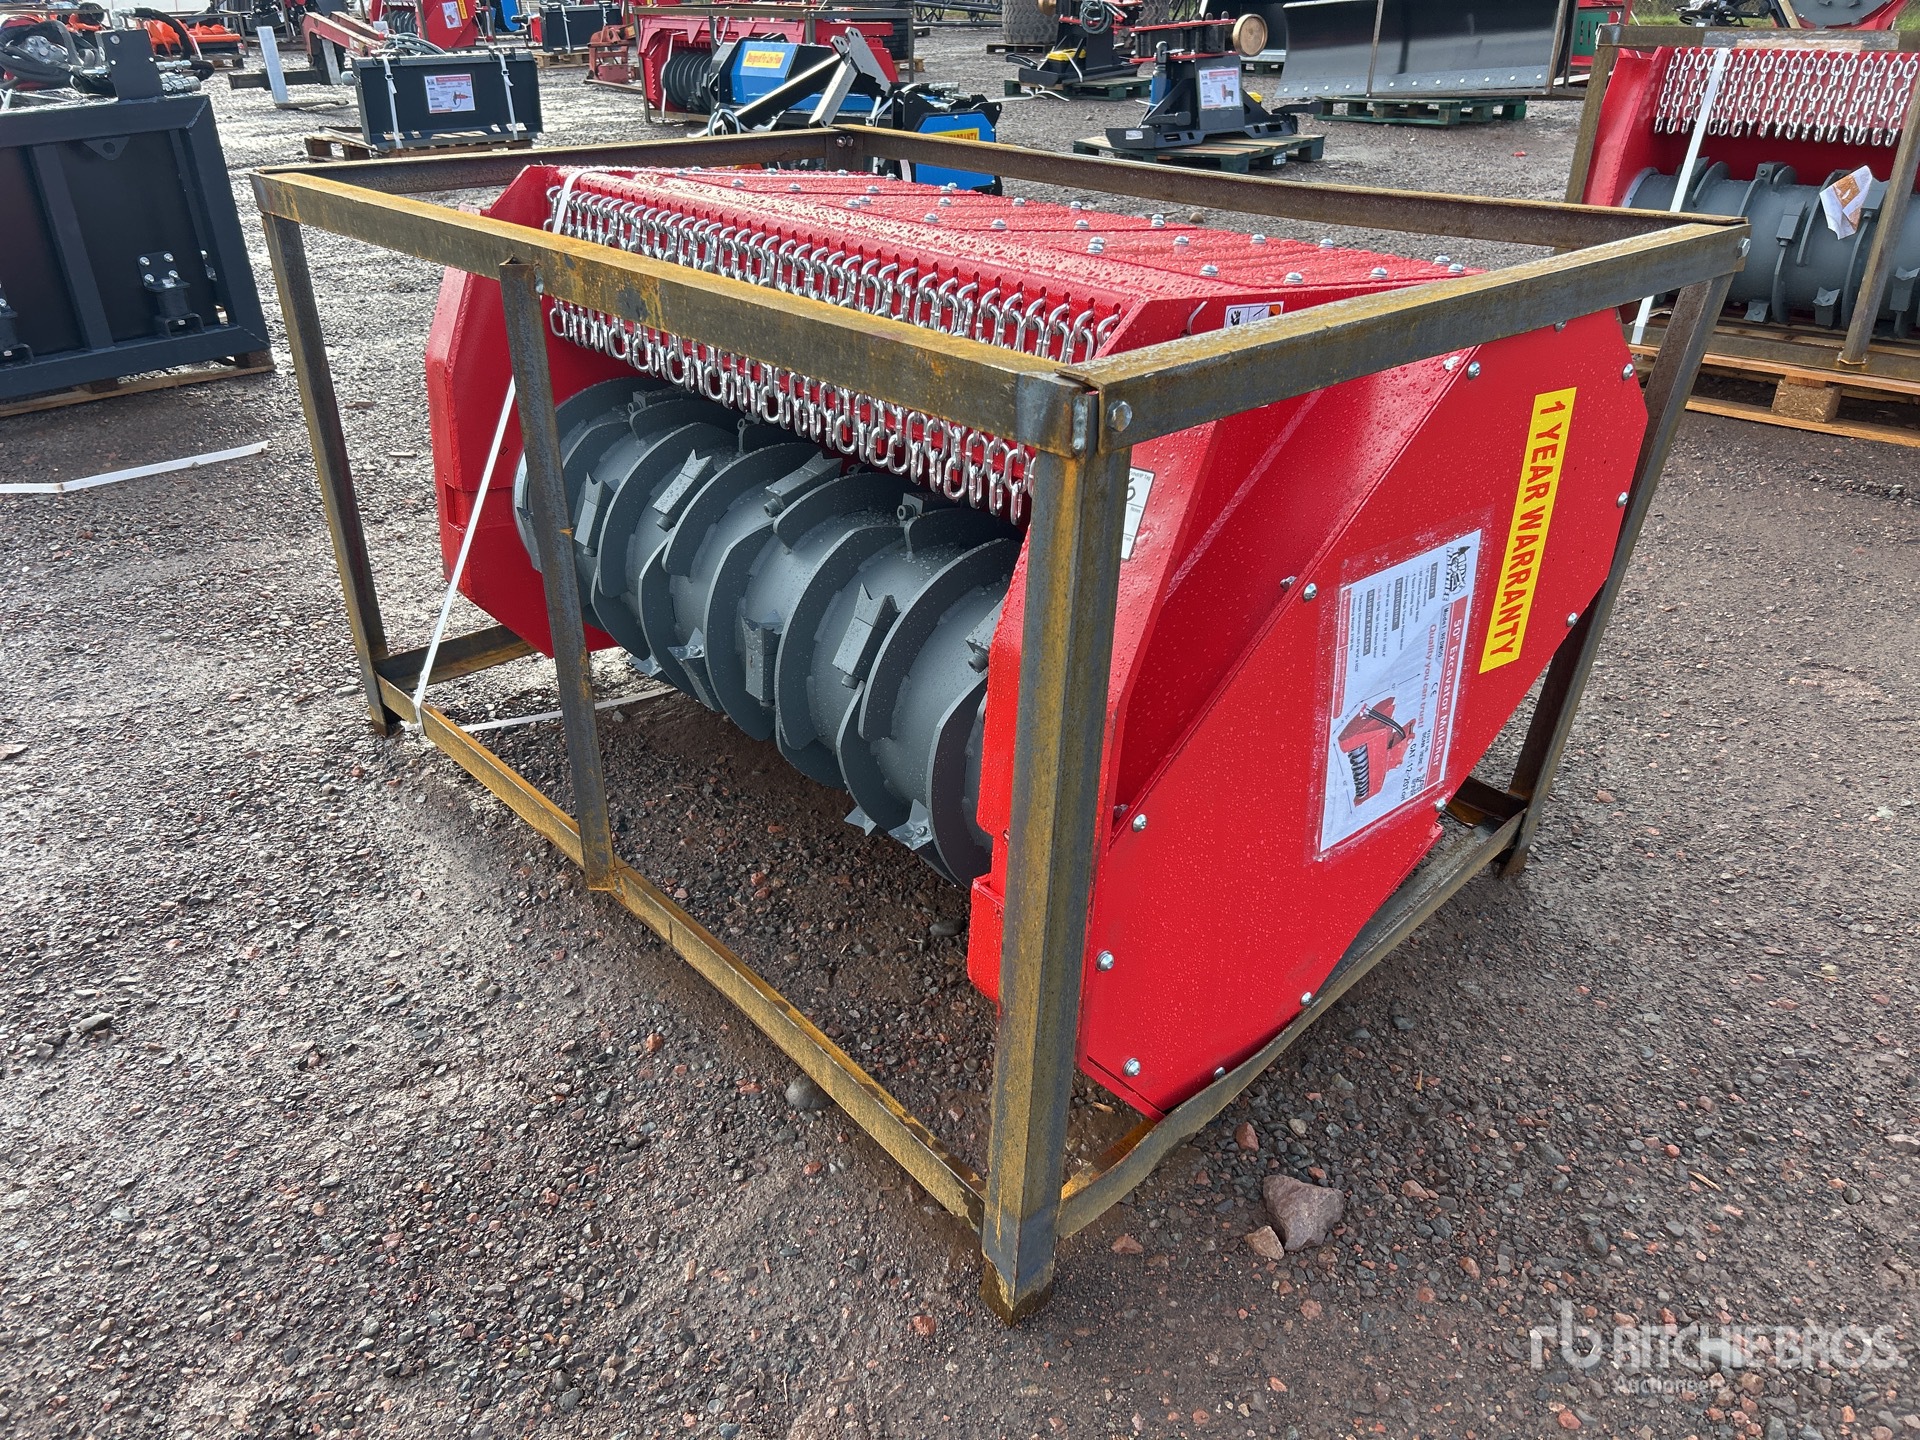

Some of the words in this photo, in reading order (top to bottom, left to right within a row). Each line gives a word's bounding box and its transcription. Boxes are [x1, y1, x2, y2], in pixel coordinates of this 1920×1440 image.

[1539, 399, 1567, 415] 1
[1522, 421, 1563, 504] YEAR
[1488, 504, 1546, 660] WARRANTY
[1424, 622, 1437, 662] Quality
[1450, 617, 1462, 643] 50"
[1422, 660, 1431, 683] you
[1440, 644, 1458, 712] Excavator
[1420, 681, 1428, 701] can
[1417, 700, 1426, 730] trust!
[1432, 713, 1448, 767] Mulcher
